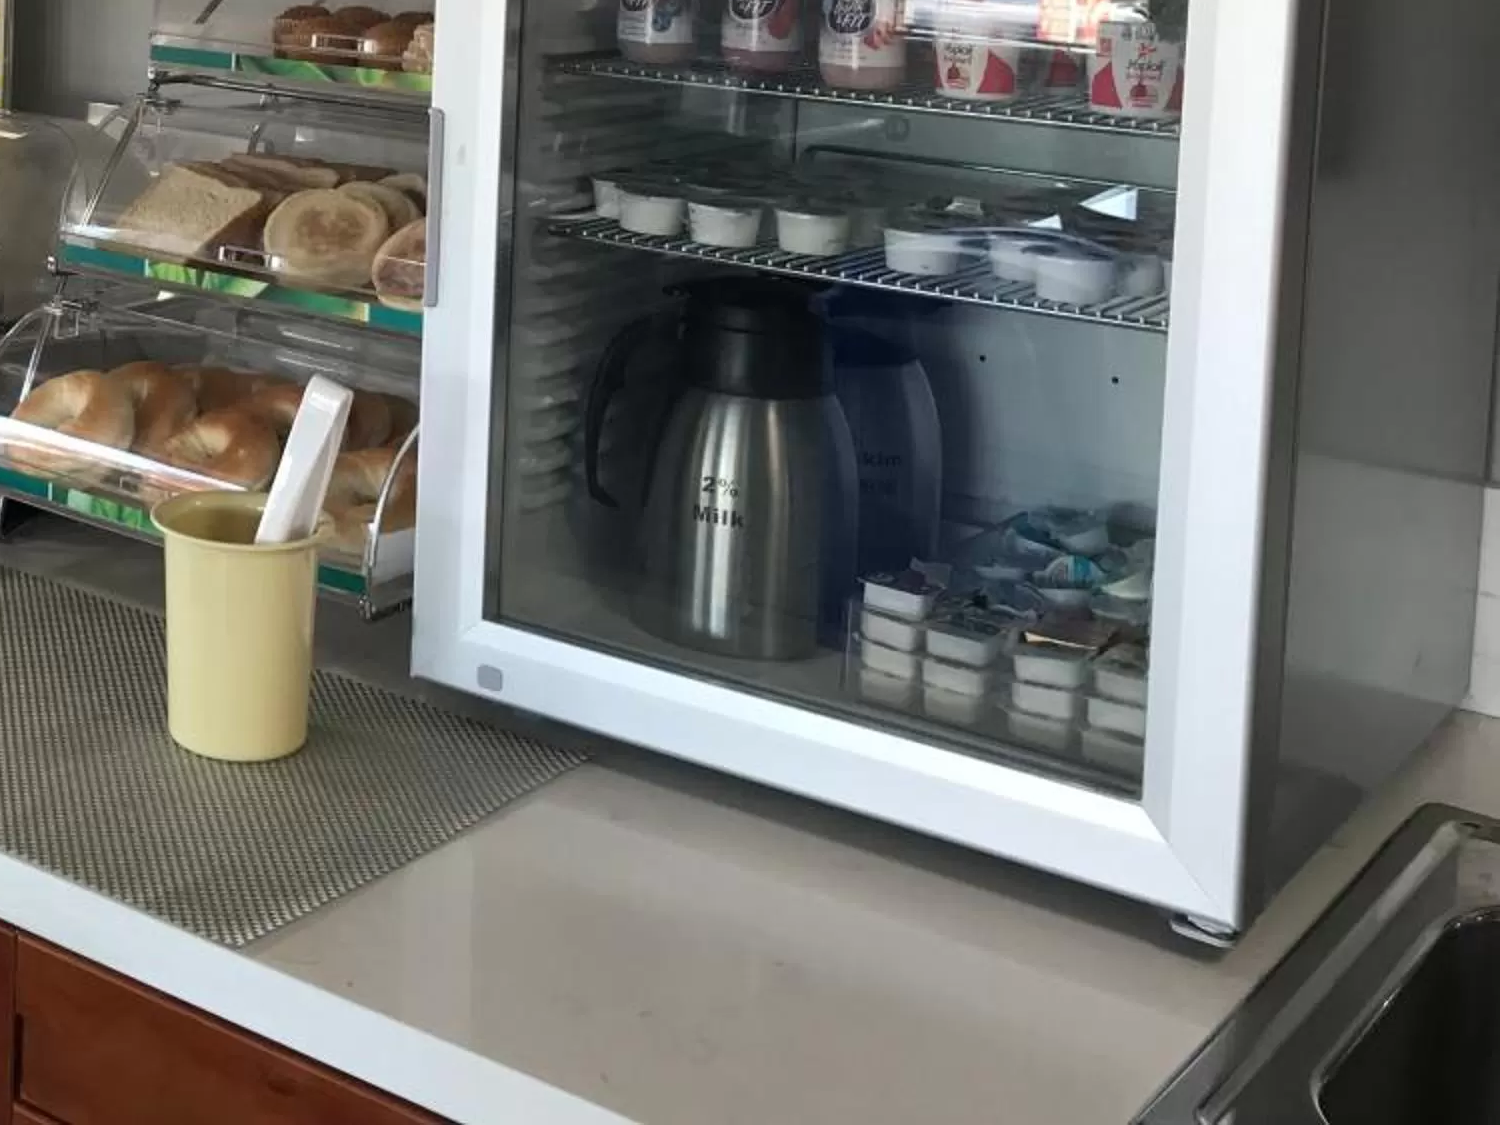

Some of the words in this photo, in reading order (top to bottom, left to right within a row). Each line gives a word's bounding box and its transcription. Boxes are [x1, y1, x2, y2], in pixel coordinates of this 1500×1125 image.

[857, 450, 902, 468] kim
[702, 476, 739, 499] 2%
[692, 504, 744, 528] Milk
